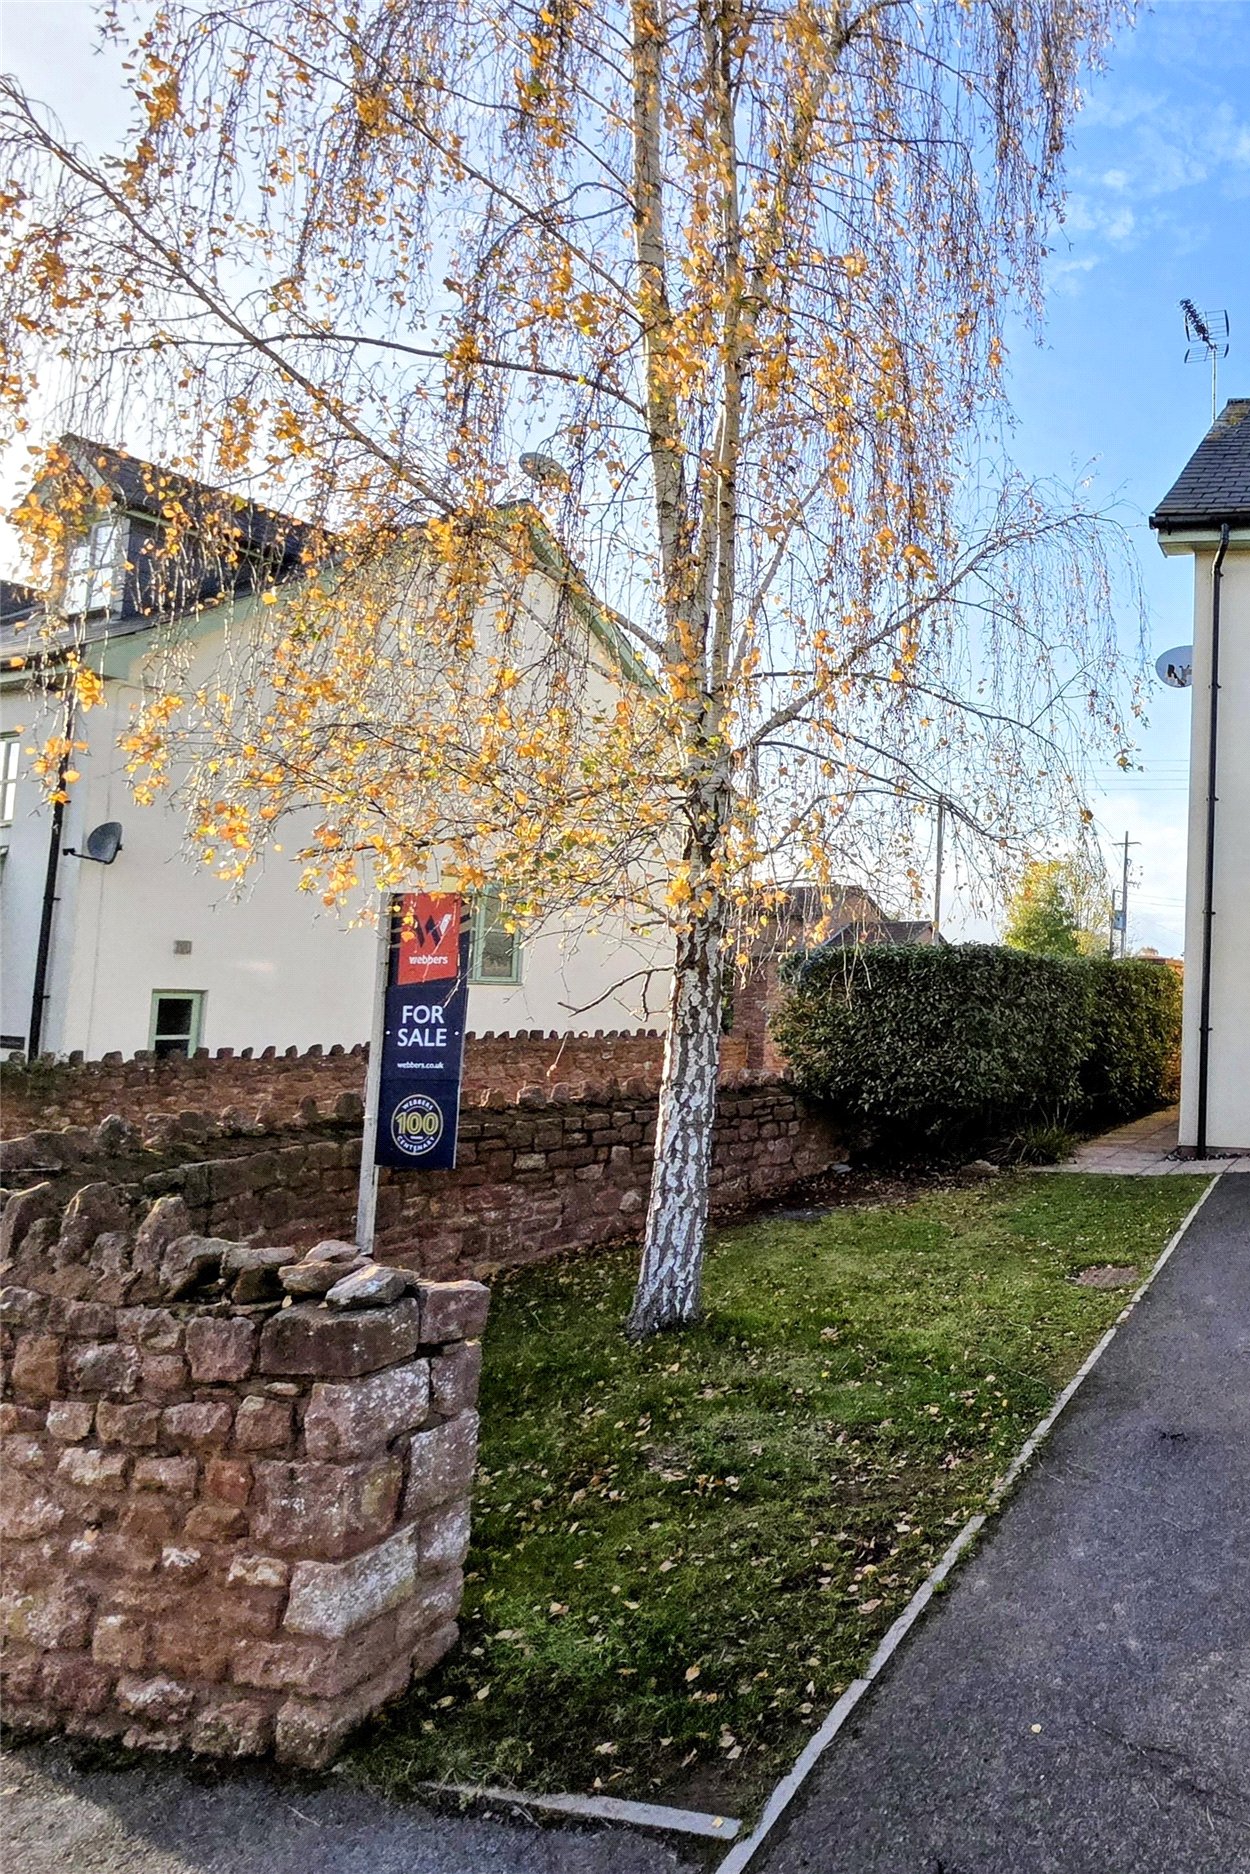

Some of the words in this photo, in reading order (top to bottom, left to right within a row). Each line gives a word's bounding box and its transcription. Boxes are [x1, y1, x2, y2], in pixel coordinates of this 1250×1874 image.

[408, 954, 449, 965] webbers
[402, 1004, 445, 1025] FOR
[397, 1027, 448, 1047] SALE
[396, 1061, 445, 1070] webbers.co.uk
[402, 1098, 434, 1111] WEBBERS
[395, 1111, 439, 1136] 100
[397, 1135, 435, 1153] CENTENARY
